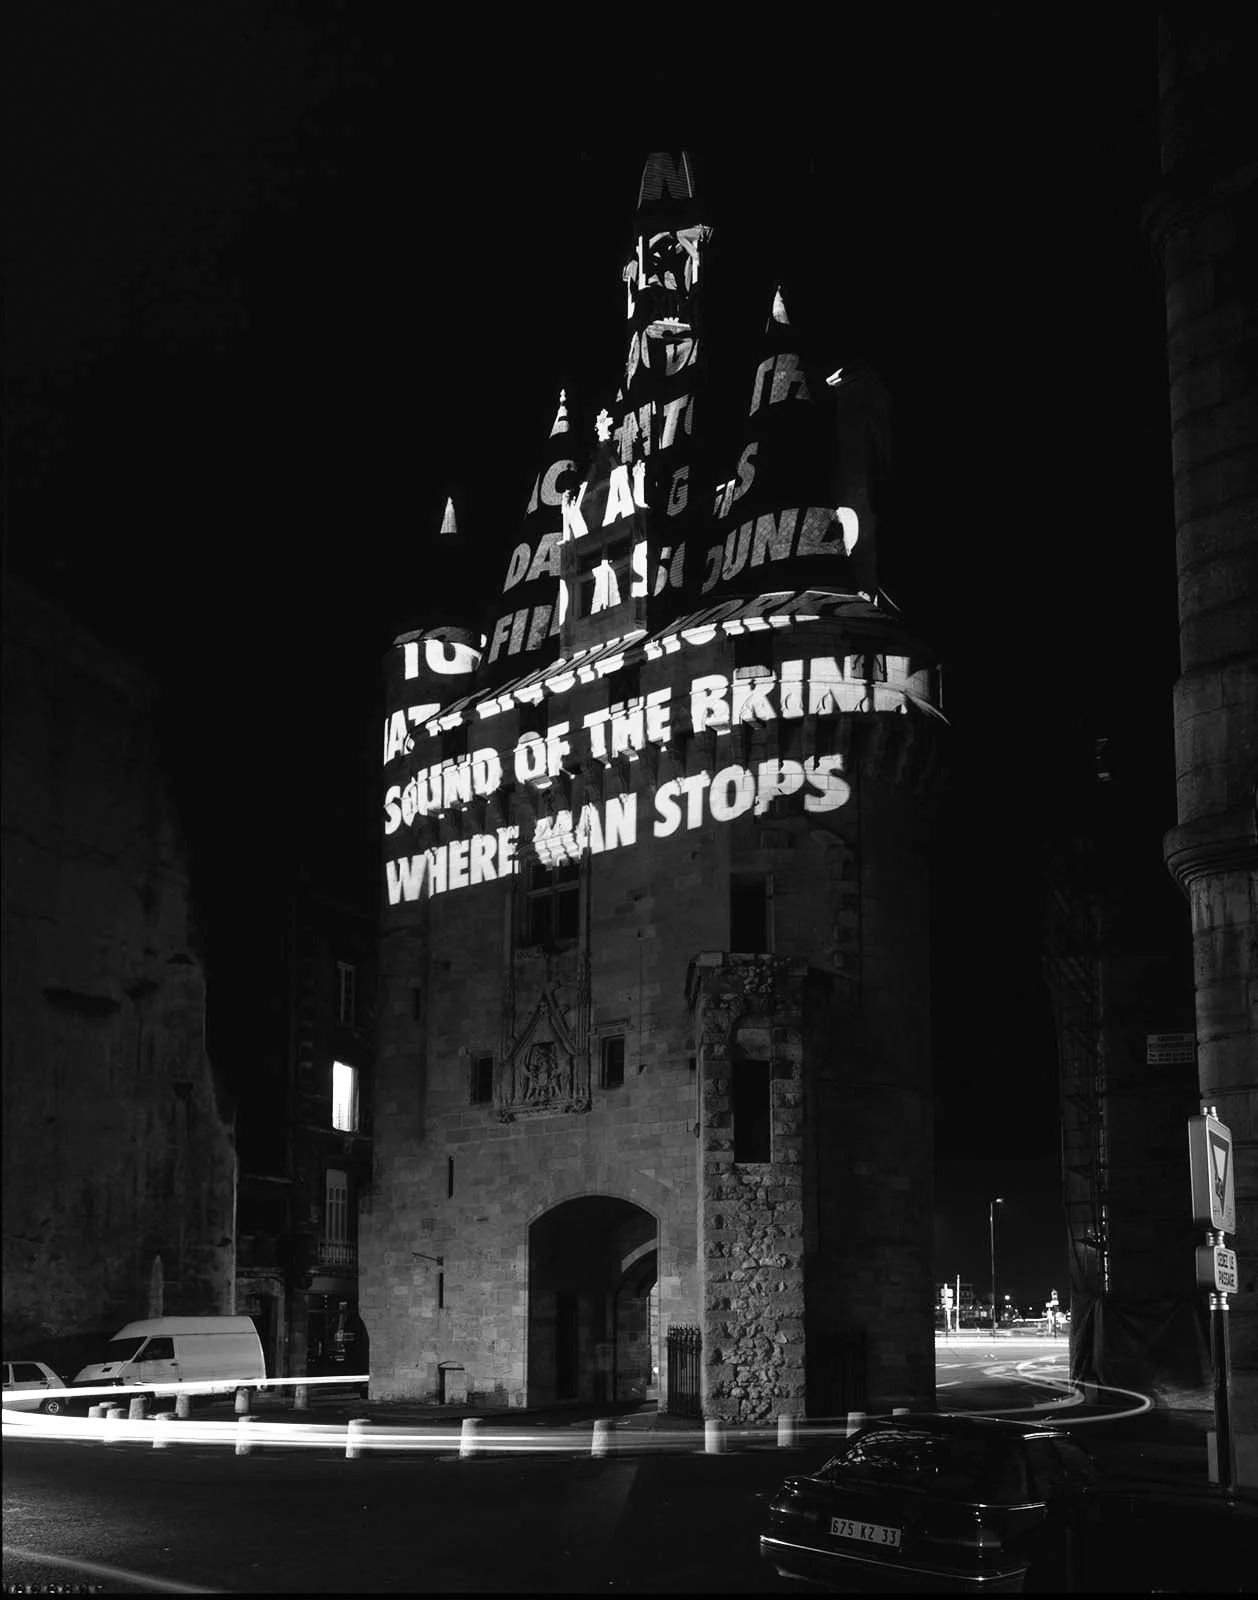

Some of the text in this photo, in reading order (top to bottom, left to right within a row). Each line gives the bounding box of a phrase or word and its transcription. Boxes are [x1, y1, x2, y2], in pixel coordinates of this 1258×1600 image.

[385, 747, 503, 834] SOUND
[514, 721, 572, 788] OF
[583, 687, 672, 769] THE
[690, 654, 932, 735] BRINK
[385, 753, 851, 905] WHERE MAN STOPS
[832, 1519, 897, 1545] 675 KZ 33
